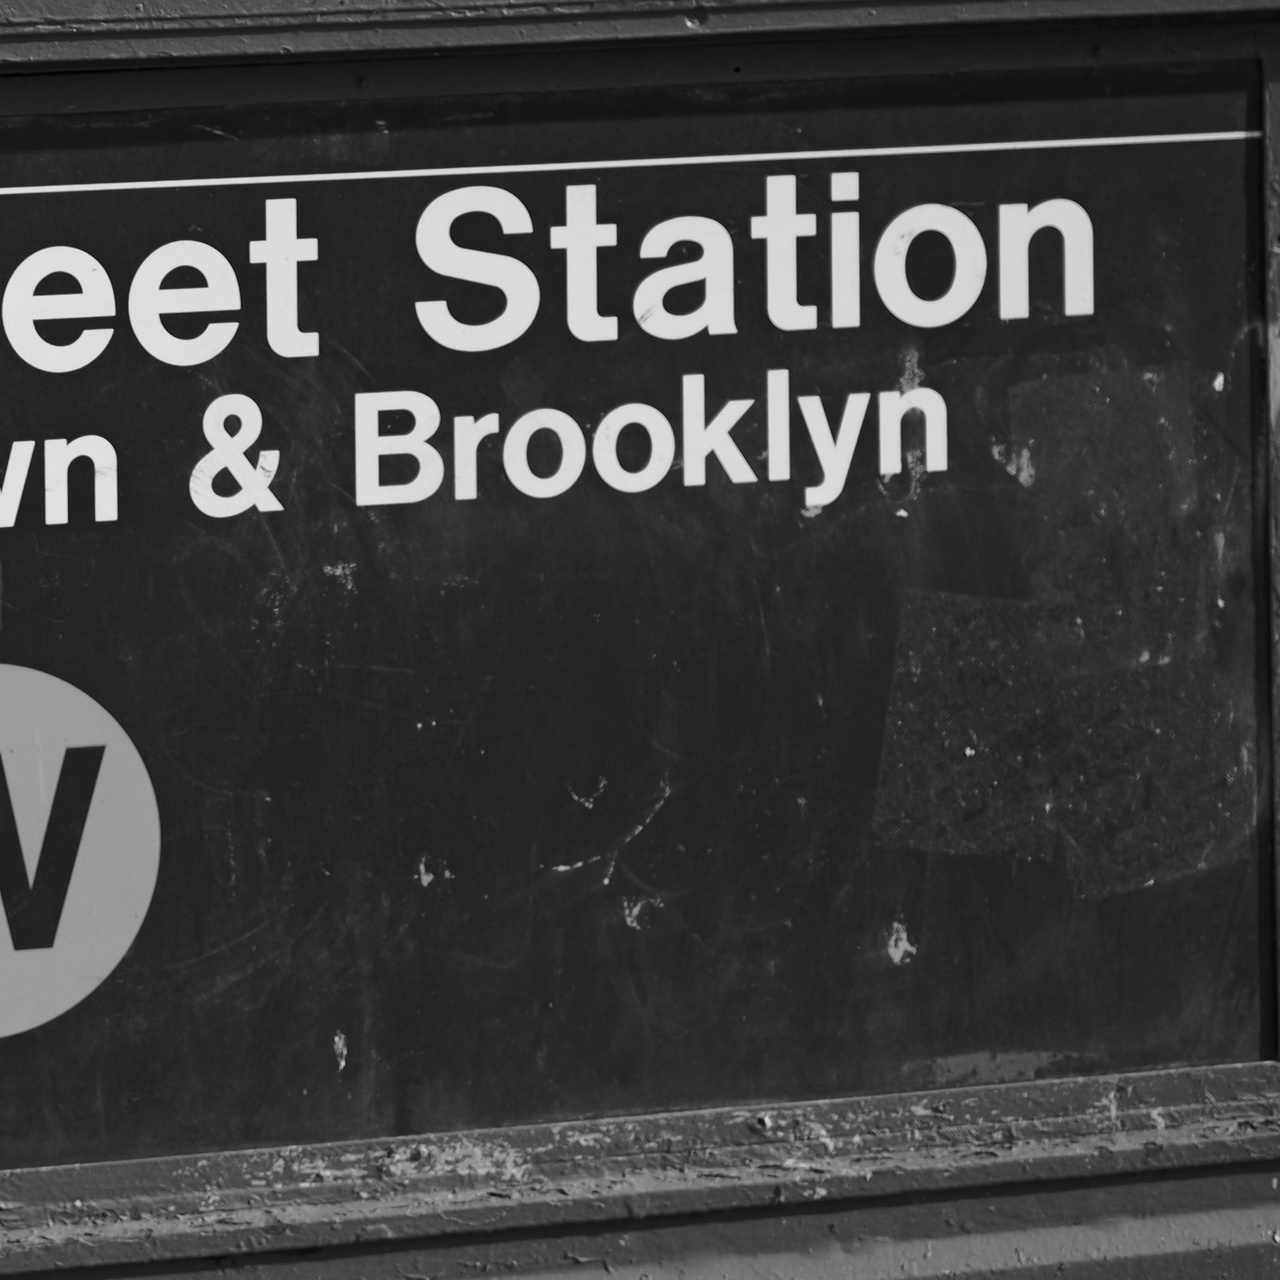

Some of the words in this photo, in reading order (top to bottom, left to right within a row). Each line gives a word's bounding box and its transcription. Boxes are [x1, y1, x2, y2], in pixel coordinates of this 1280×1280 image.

[414, 170, 1097, 354] Station
[187, 392, 285, 520] &
[353, 367, 950, 510] Brooklyn
